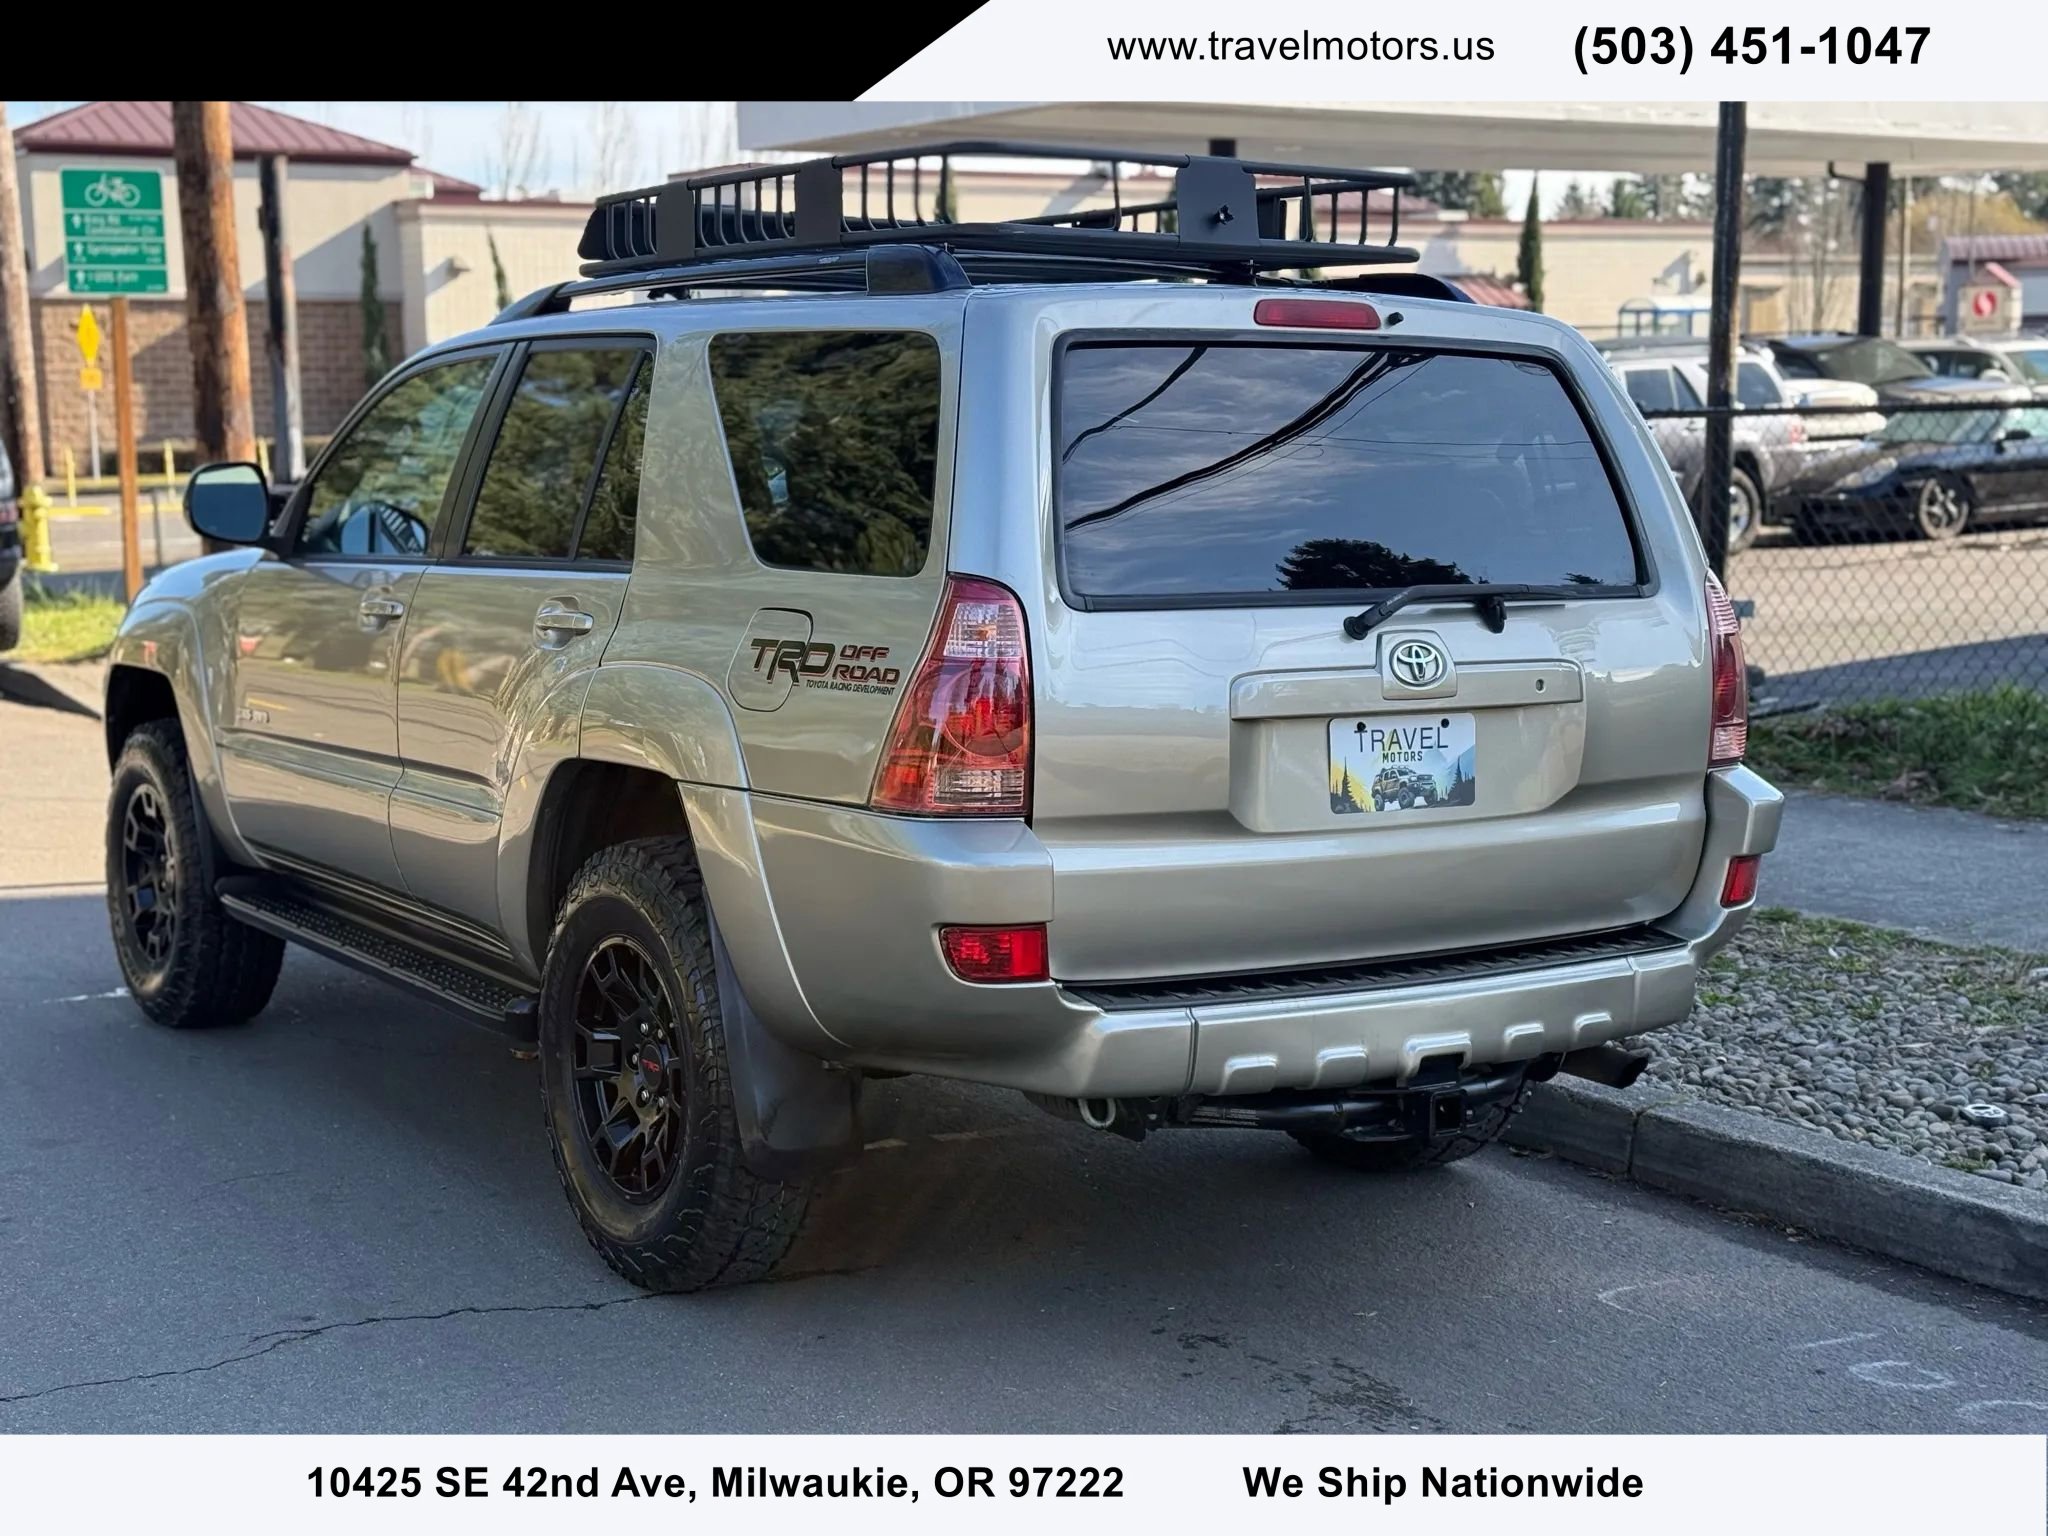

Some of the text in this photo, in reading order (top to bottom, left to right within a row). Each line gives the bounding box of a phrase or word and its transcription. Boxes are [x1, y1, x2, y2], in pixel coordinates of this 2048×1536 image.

[751, 638, 836, 687] TRD
[839, 644, 890, 663] OFF
[832, 664, 900, 685] ROAD
[806, 679, 896, 696] TOYOTA RACING DEVELOPMENT
[1354, 726, 1449, 753] TRAVEL
[1382, 750, 1423, 764] MOTORS
